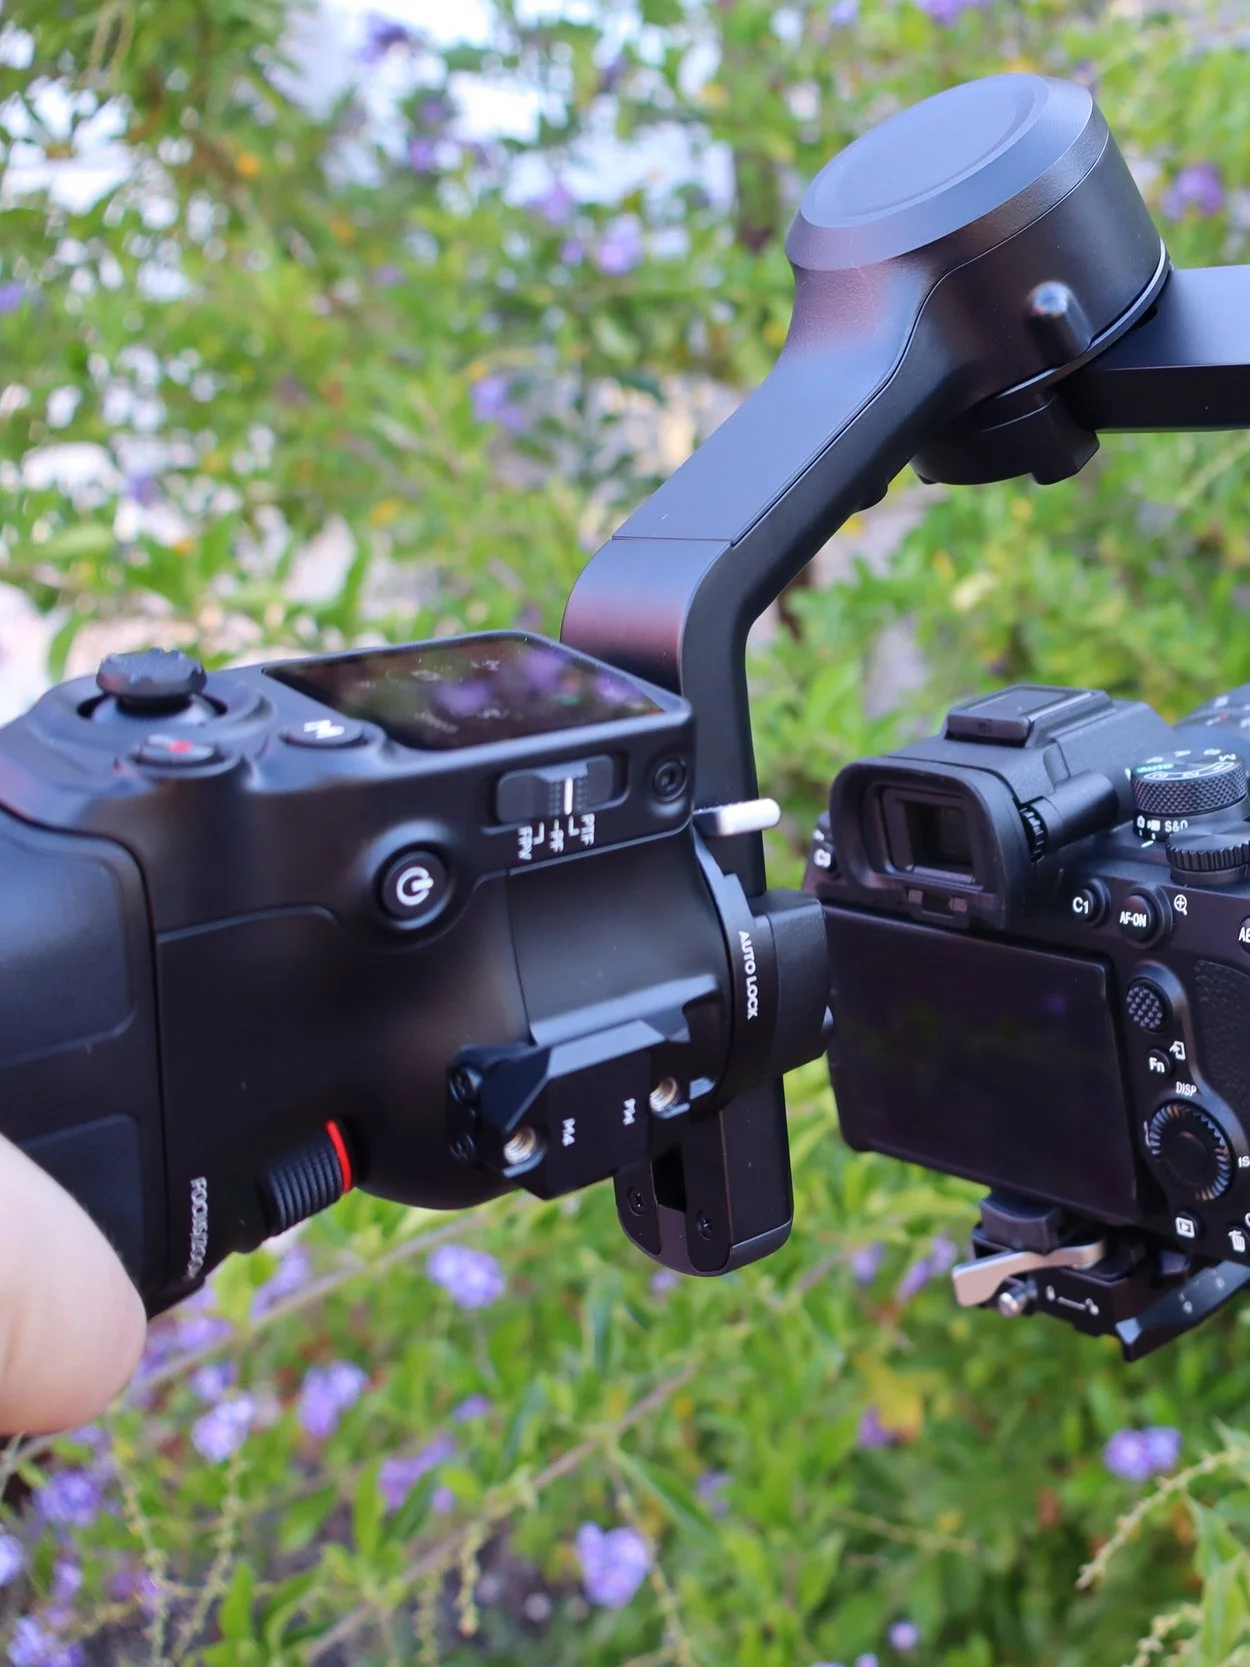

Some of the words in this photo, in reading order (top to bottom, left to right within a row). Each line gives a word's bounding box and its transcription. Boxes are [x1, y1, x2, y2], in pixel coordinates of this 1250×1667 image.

[1072, 896, 1089, 914] C1
[1119, 910, 1147, 928] AF-ON
[738, 930, 756, 975] AUTO
[746, 975, 759, 1021] LOCK
[1149, 1057, 1165, 1074] Fn
[1176, 1081, 1197, 1097] DISP
